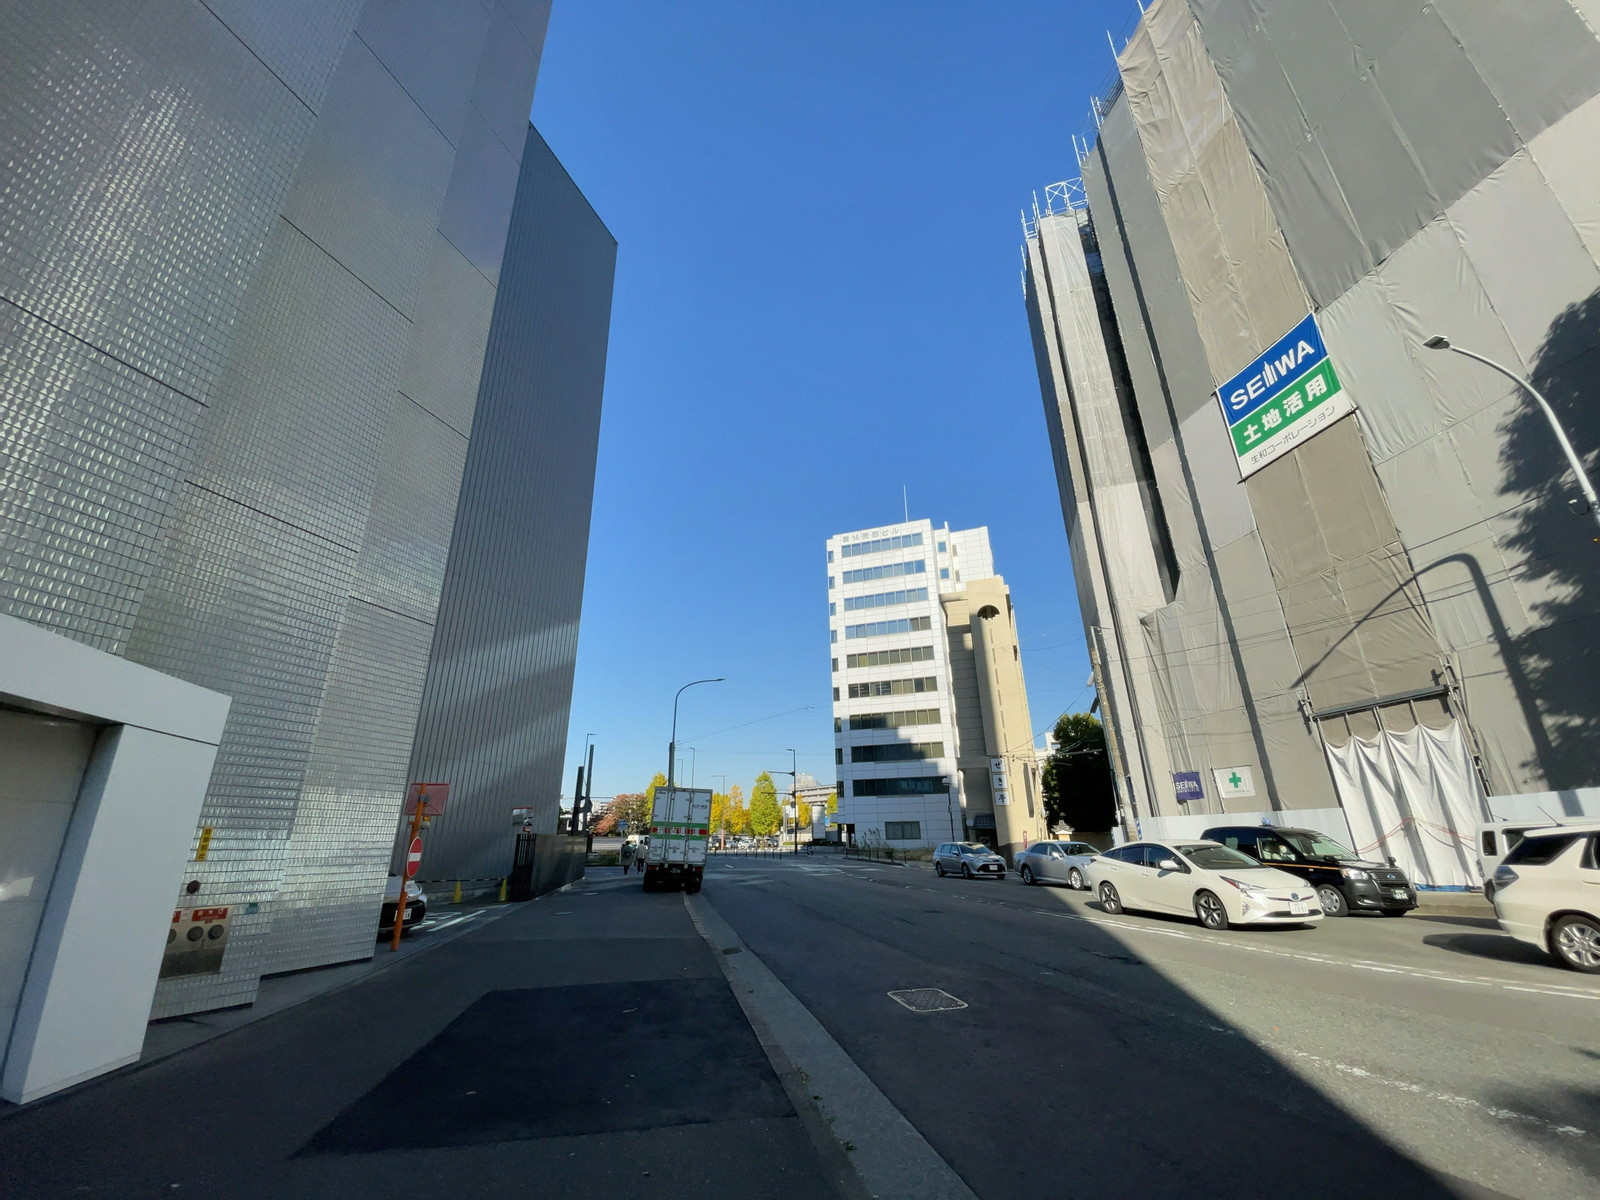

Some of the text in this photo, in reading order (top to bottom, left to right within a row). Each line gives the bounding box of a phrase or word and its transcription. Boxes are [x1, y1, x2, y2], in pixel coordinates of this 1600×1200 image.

[1230, 340, 1315, 411] SEIWA
[1243, 373, 1329, 445] 土地活用
[1250, 405, 1335, 465] 生和コーポレーション
